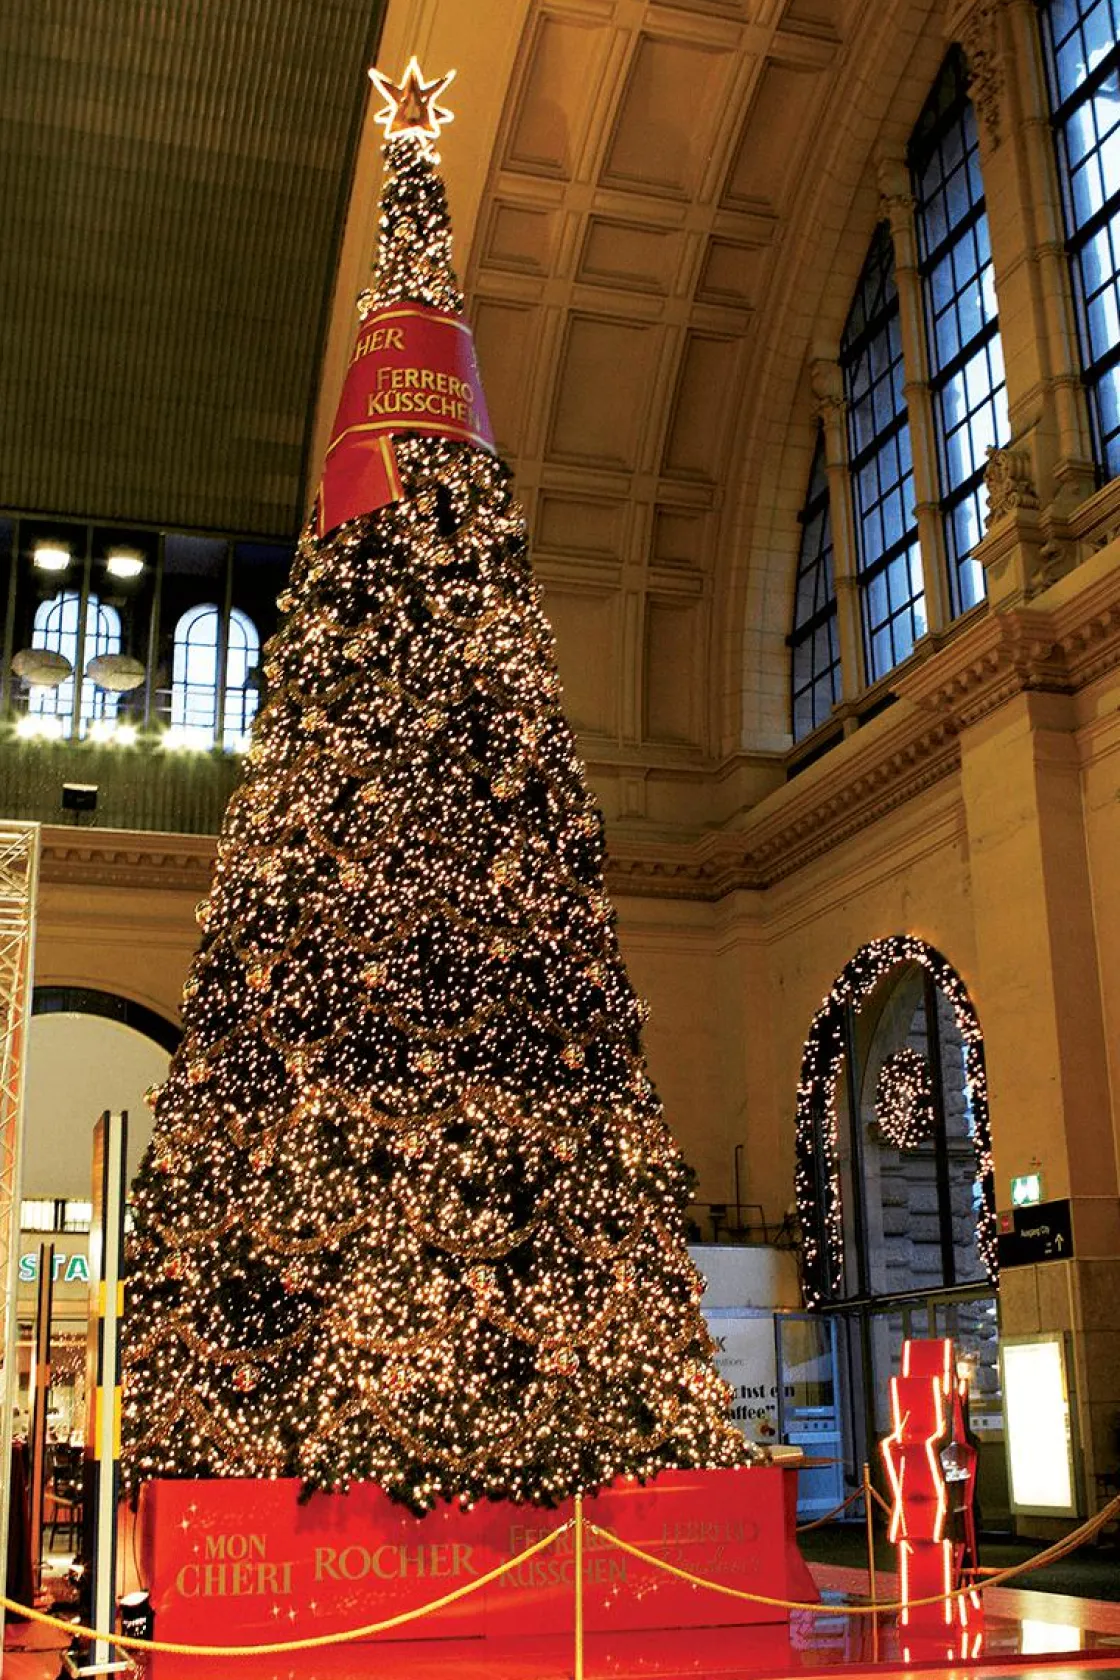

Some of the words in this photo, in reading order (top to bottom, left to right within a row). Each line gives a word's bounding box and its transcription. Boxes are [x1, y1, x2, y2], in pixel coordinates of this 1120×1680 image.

[350, 328, 405, 364] HER
[376, 366, 474, 401] FERRERO
[204, 1534, 267, 1560] MON
[313, 1543, 478, 1582] ROCHER
